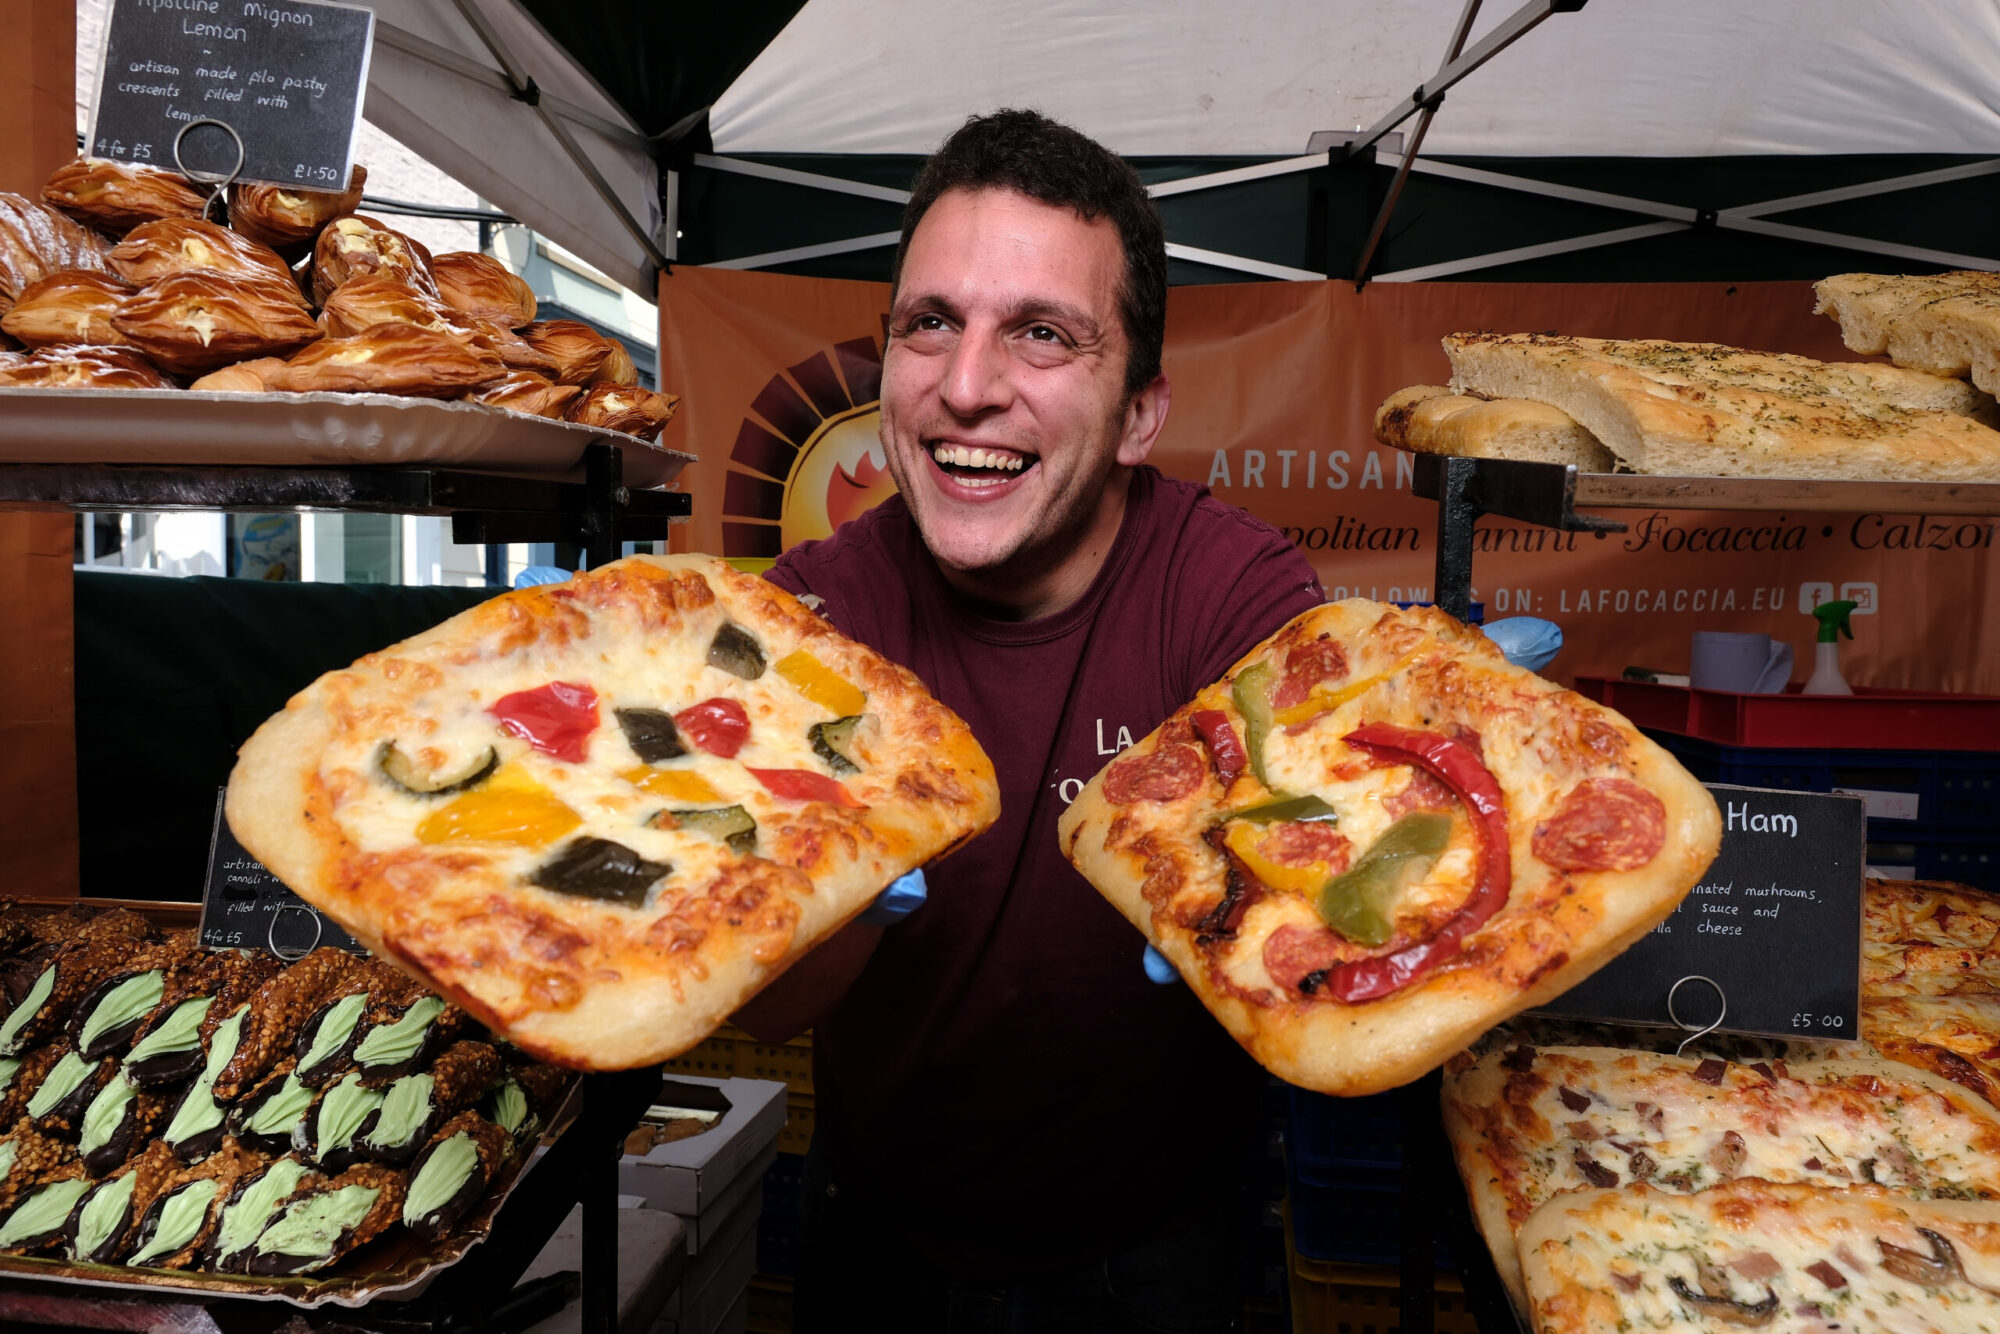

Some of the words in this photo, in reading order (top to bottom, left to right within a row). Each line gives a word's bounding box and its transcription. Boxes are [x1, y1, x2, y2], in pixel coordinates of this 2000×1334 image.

[243, 3, 313, 28] Mignon
[182, 17, 247, 43] Lemon
[129, 60, 180, 75] artisan
[195, 65, 237, 80] made
[248, 70, 275, 86] filo
[282, 75, 328, 98] pastry
[118, 82, 180, 98] crescents
[204, 88, 244, 102] filled
[256, 95, 289, 110] with
[97, 138, 108, 153] 4
[109, 139, 127, 157] for
[133, 143, 153, 158] £5
[1282, 514, 1421, 552] politan
[1472, 526, 1578, 553] anini
[1623, 511, 1809, 553] Focaccia
[1495, 588, 1543, 612] ON:
[1559, 587, 1785, 613] LAFOCACCIA.EU
[1726, 800, 1798, 838] Ham
[1692, 880, 1733, 896] inated
[226, 900, 257, 916] filled
[1702, 902, 1739, 916] sauce
[1753, 902, 1780, 919] and
[204, 928, 211, 941] 4
[227, 931, 243, 944] £5
[1697, 918, 1743, 936] cheese
